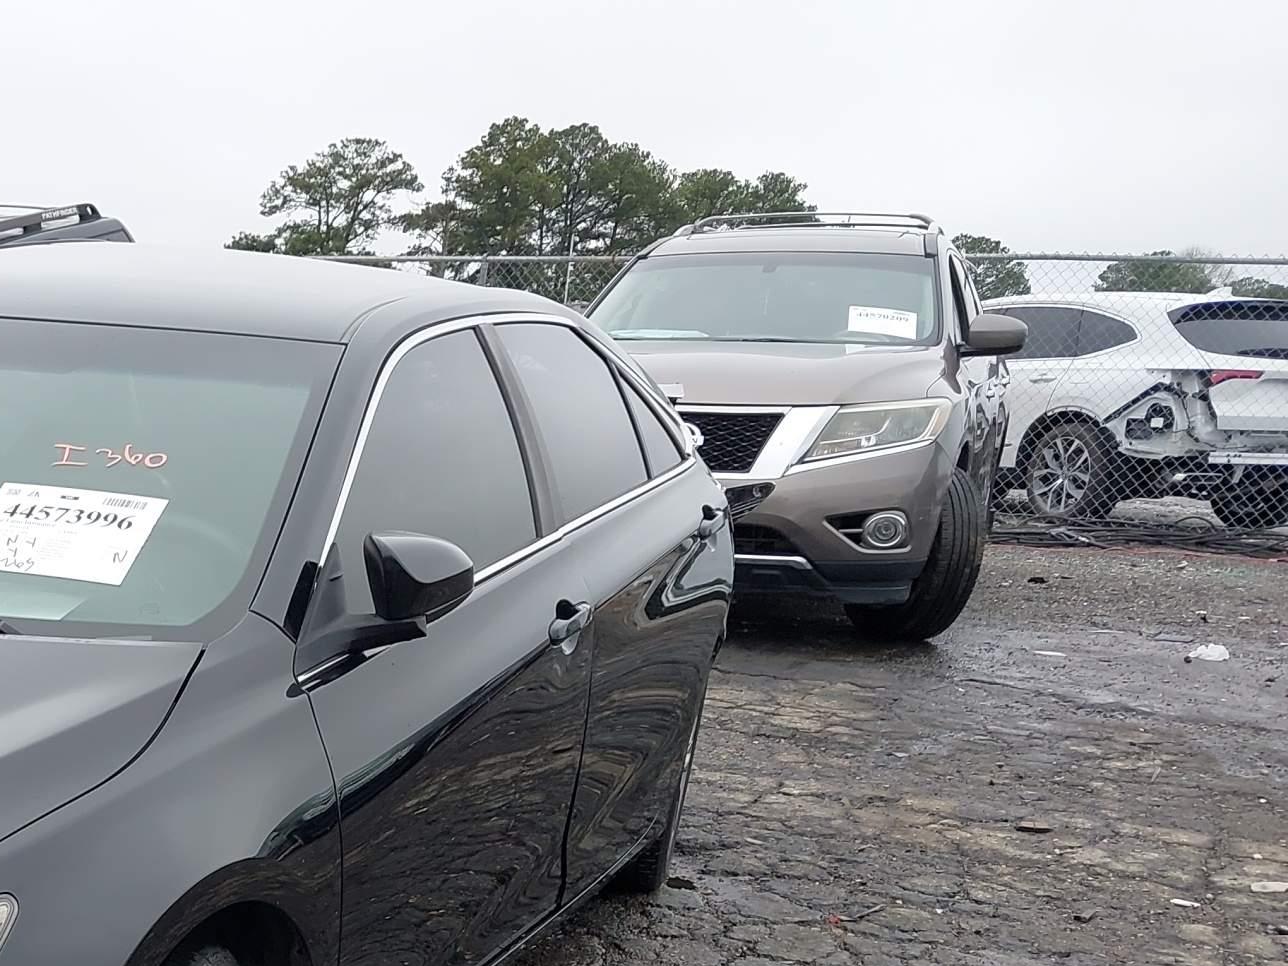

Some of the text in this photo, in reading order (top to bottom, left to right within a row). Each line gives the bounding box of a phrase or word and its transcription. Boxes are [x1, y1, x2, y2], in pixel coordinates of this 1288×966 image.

[41, 207, 78, 220] PATHFINDER
[95, 443, 168, 469] 360
[3, 503, 136, 530] 44573996
